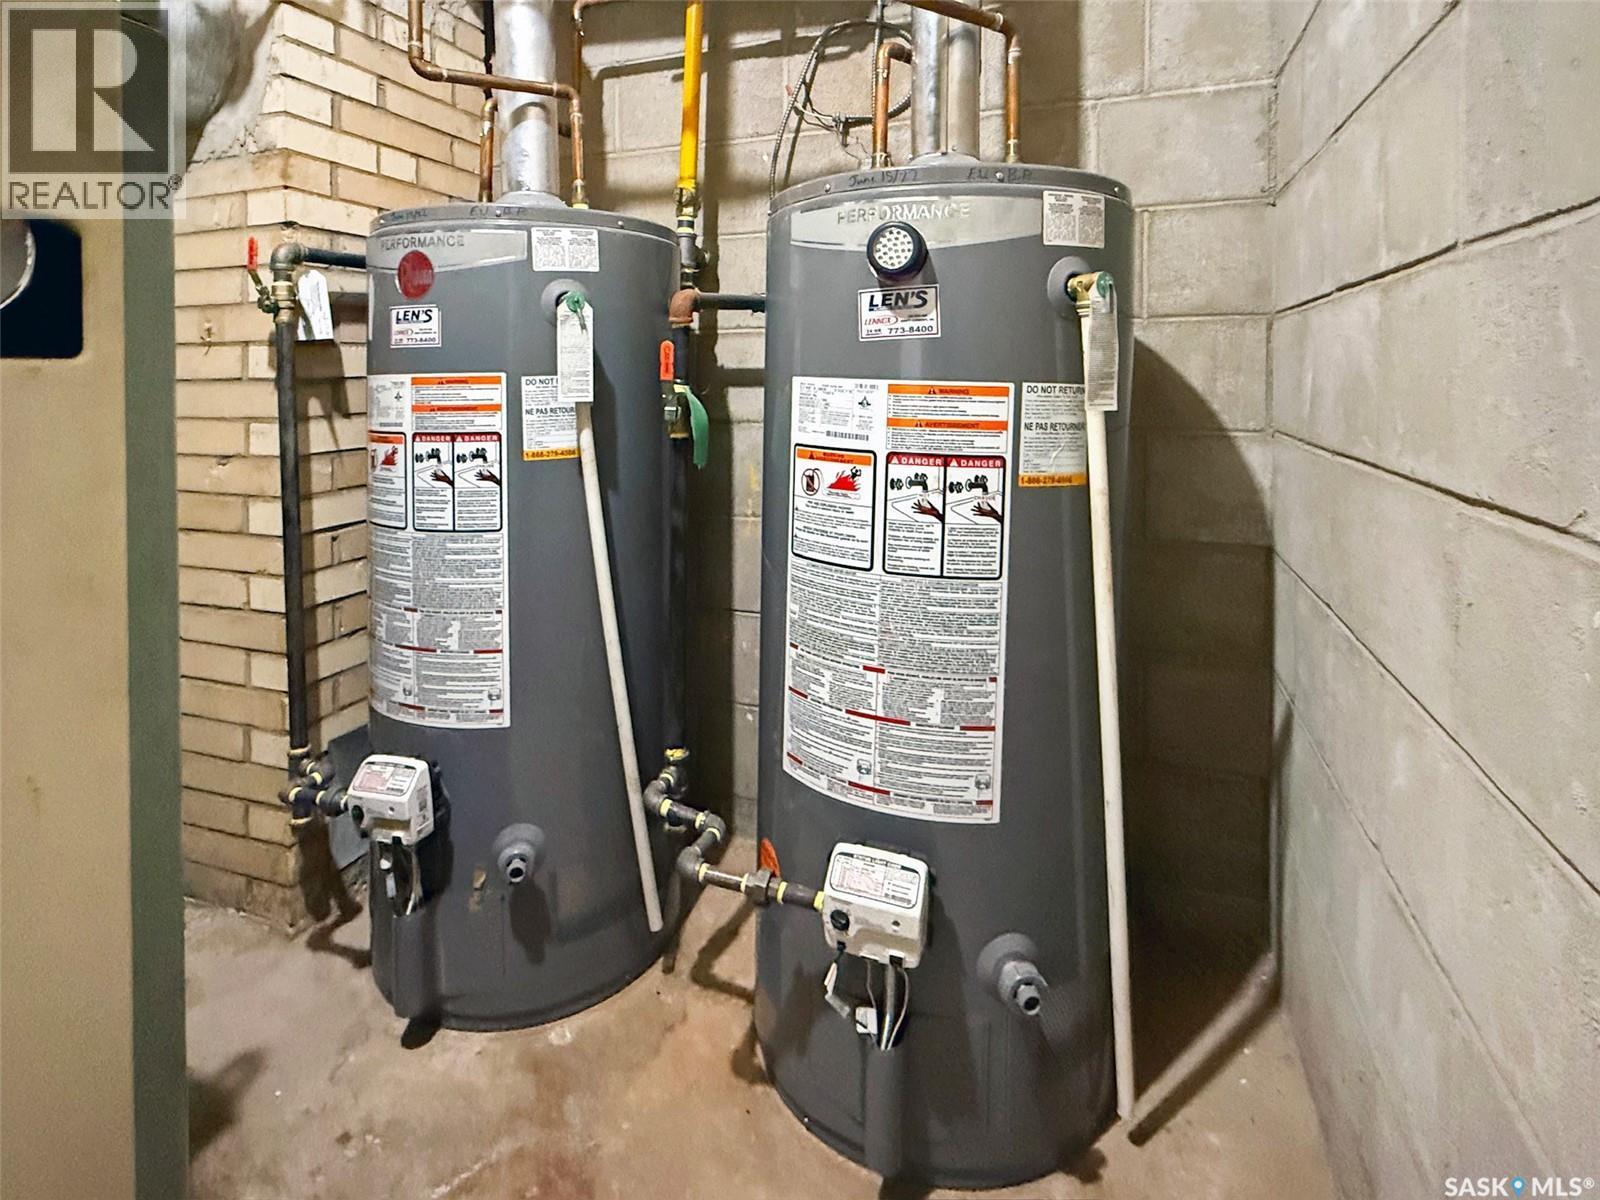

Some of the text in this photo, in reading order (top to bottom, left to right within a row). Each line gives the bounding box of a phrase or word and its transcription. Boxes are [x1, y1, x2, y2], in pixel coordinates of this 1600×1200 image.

[837, 203, 970, 224] PERFORMANCE
[380, 234, 465, 251] PERFORMANCE
[868, 290, 929, 311] LEN'S
[395, 309, 433, 324] LEN'S
[888, 325, 934, 335] 773-8400
[525, 377, 553, 386] DO NOT
[1026, 385, 1039, 394] DO
[1041, 386, 1057, 394] NOT
[536, 407, 548, 415] PAS
[1024, 421, 1034, 431] NE
[1035, 422, 1049, 431] PAS
[421, 434, 451, 442] DANGER
[463, 434, 498, 442] DANGER
[901, 456, 942, 466] DANGER
[960, 459, 1001, 468] DANGER
